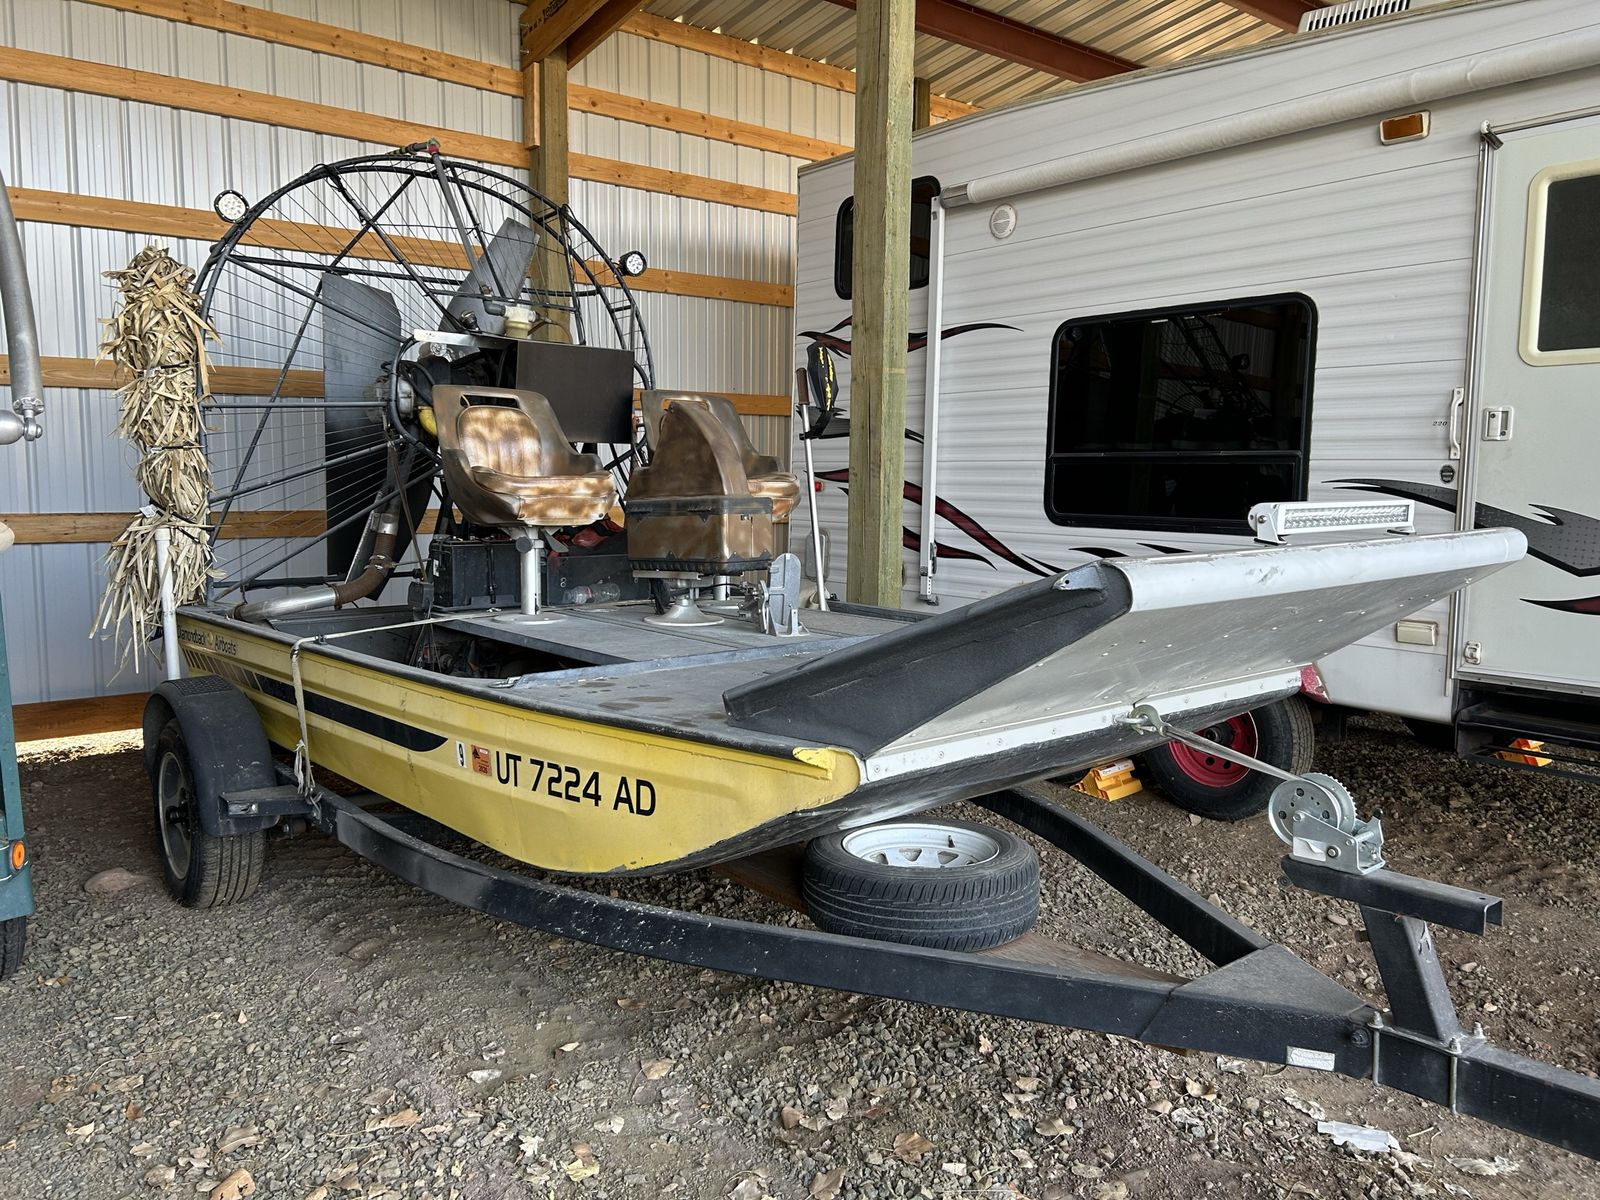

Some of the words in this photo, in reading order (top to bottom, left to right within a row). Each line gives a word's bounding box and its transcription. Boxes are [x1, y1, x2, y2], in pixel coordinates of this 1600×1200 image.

[214, 634, 237, 656] Airboats
[495, 750, 522, 787] UT
[529, 758, 602, 807] 7224
[612, 776, 657, 817] AD
